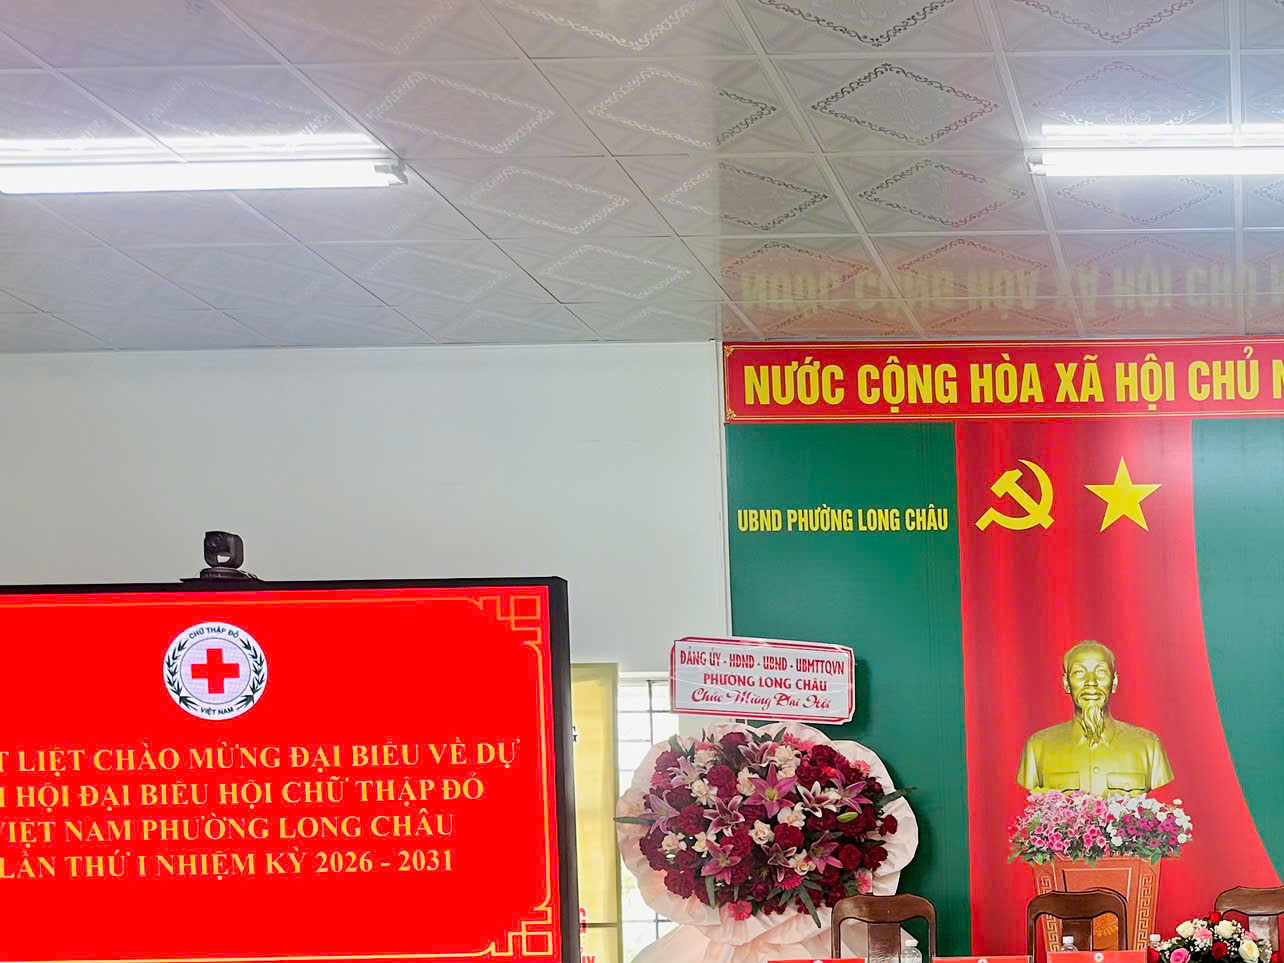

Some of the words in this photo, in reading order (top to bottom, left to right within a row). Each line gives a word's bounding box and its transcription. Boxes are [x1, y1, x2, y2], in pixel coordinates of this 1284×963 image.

[743, 356, 844, 405] NƯỚC
[857, 355, 958, 413] CỘNG
[970, 353, 1044, 404] HÒA
[1055, 354, 1104, 403] XÃ
[1116, 353, 1175, 410] HỘI
[1188, 346, 1259, 400] CHỦ
[737, 509, 782, 532] UBND
[787, 504, 854, 532] PHƯỜNG
[858, 508, 900, 531] LONG
[905, 504, 949, 531] CHÂU
[680, 646, 707, 666] ĐẢNG
[763, 656, 788, 671] UBND
[796, 658, 845, 676] UBMTTQVN
[691, 687, 722, 703] Chúc
[759, 676, 792, 689] LONG
[218, 707, 234, 715] NAM
[18, 747, 86, 777] LIỆT
[93, 742, 180, 771] CHÀO
[189, 740, 280, 770] MỪNG
[291, 745, 342, 773] ĐẠI
[351, 737, 419, 767] BIỂU
[428, 737, 467, 765] VỀ
[477, 738, 521, 769] DỰ
[16, 782, 70, 813] HỘI
[79, 784, 130, 812] ĐẠI
[140, 780, 209, 806] BIỂU
[219, 780, 272, 809] HỘI
[281, 776, 349, 803] CHỮ
[356, 777, 435, 807] THẬP
[442, 772, 484, 800] ĐỎ
[65, 819, 131, 842] NAM
[142, 813, 269, 840] PHƯỜNG
[279, 816, 361, 839] LONG
[370, 808, 454, 837] CHÂU
[0, 850, 56, 878] LẦN
[64, 850, 131, 877] THỨ
[136, 856, 146, 876] I
[157, 852, 256, 880] NHIỆM
[265, 846, 306, 874] KỲ
[315, 852, 373, 873] 2026
[398, 849, 453, 871] 2031
